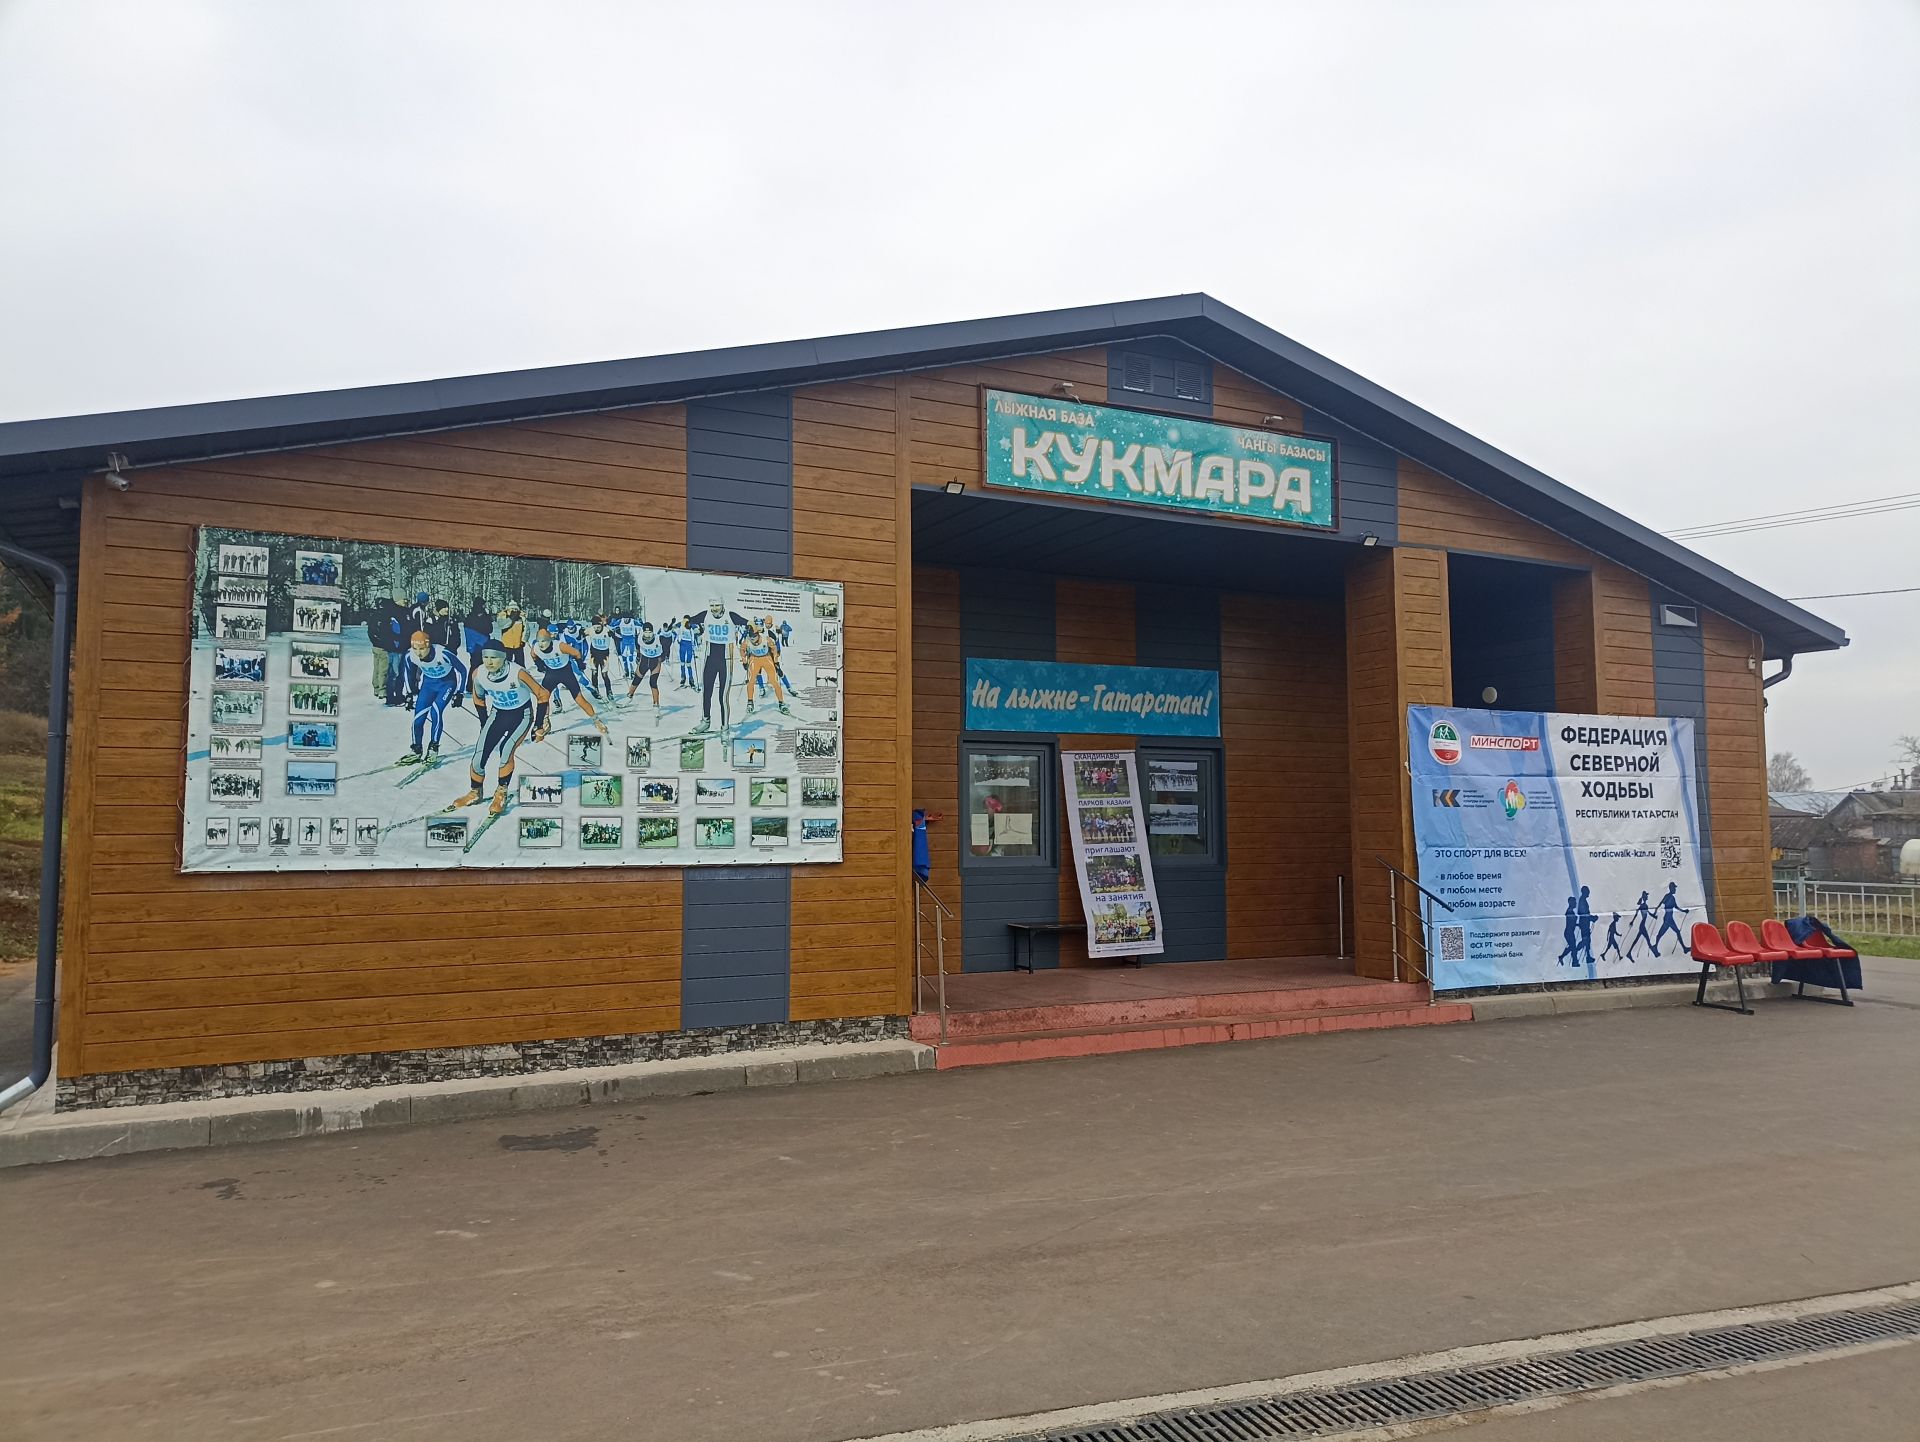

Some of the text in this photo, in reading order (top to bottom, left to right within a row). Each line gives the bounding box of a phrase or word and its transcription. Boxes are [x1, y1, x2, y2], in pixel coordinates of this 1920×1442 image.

[995, 400, 1095, 427] ЛЫЖНАЯ БАЗА
[1280, 444, 1326, 462] БАЗАСЫ
[1012, 427, 1312, 513] КУКМАРА
[708, 624, 729, 635] 309
[972, 678, 1001, 708] На
[1561, 726, 1667, 748] ФЕДЕРАЦИЯ
[1471, 737, 1538, 749] МИНСПОРТ
[1074, 753, 1120, 761] СКАНДИНАВЫ
[1570, 752, 1660, 772] СЕВЕРНОЙ
[1581, 780, 1654, 800] ХОДЬБЫ
[1575, 809, 1679, 819] РЕСПУБЛИКИ ТАТАРСТАН
[1085, 846, 1136, 855] приглашают
[1435, 849, 1527, 859] ЭТО СПОРТ ДЛЯ ВСЕХ!
[1589, 849, 1656, 858] nordicwalk-kzn.ru
[1446, 872, 1475, 880] любое
[1476, 873, 1502, 881] время
[1446, 886, 1477, 894] любом
[1108, 894, 1144, 902] занятия
[1479, 900, 1516, 909] возрасте
[1469, 930, 1541, 939] Поддержите развитие
[1470, 950, 1524, 960] мобильный банк
